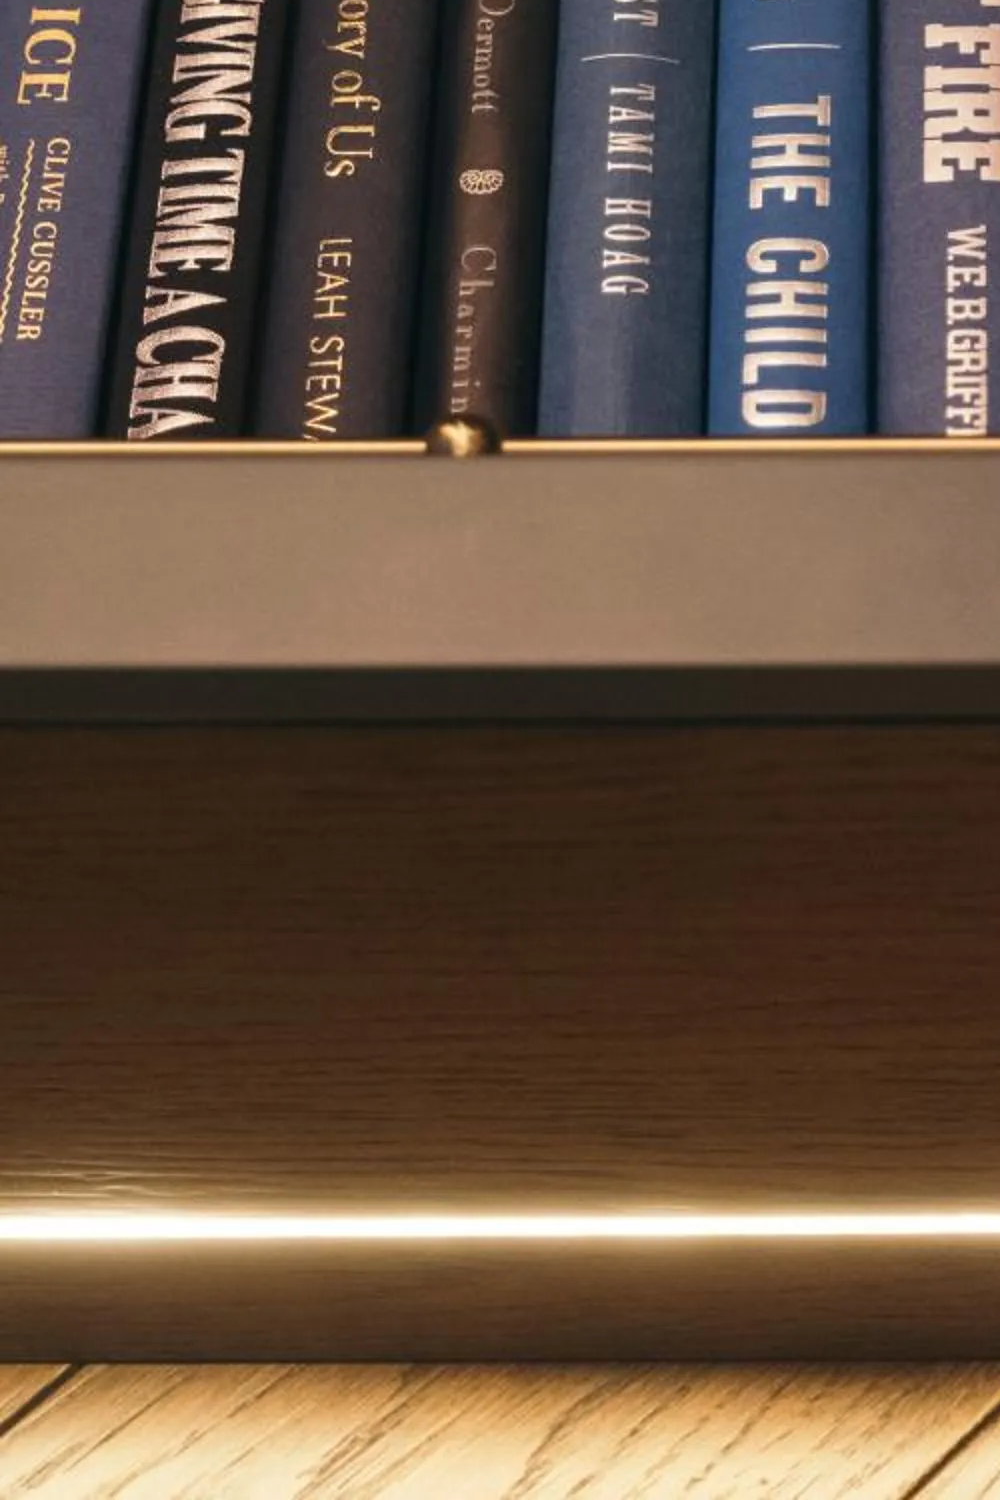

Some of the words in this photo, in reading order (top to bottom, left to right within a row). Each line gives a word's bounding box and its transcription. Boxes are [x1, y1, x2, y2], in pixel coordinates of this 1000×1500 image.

[16, 6, 82, 107] ICE
[329, 66, 382, 112] of
[38, 137, 71, 213] CLIVE
[323, 122, 373, 179] Us
[606, 83, 656, 175] TAMI
[749, 95, 831, 209] THE
[148, 148, 245, 279] TIME
[601, 198, 652, 297] HOAG
[16, 219, 61, 341] CUSSLER
[143, 285, 227, 325] A
[313, 238, 353, 319] LEAH
[741, 237, 828, 429] CHILD
[301, 336, 344, 440] STEW
